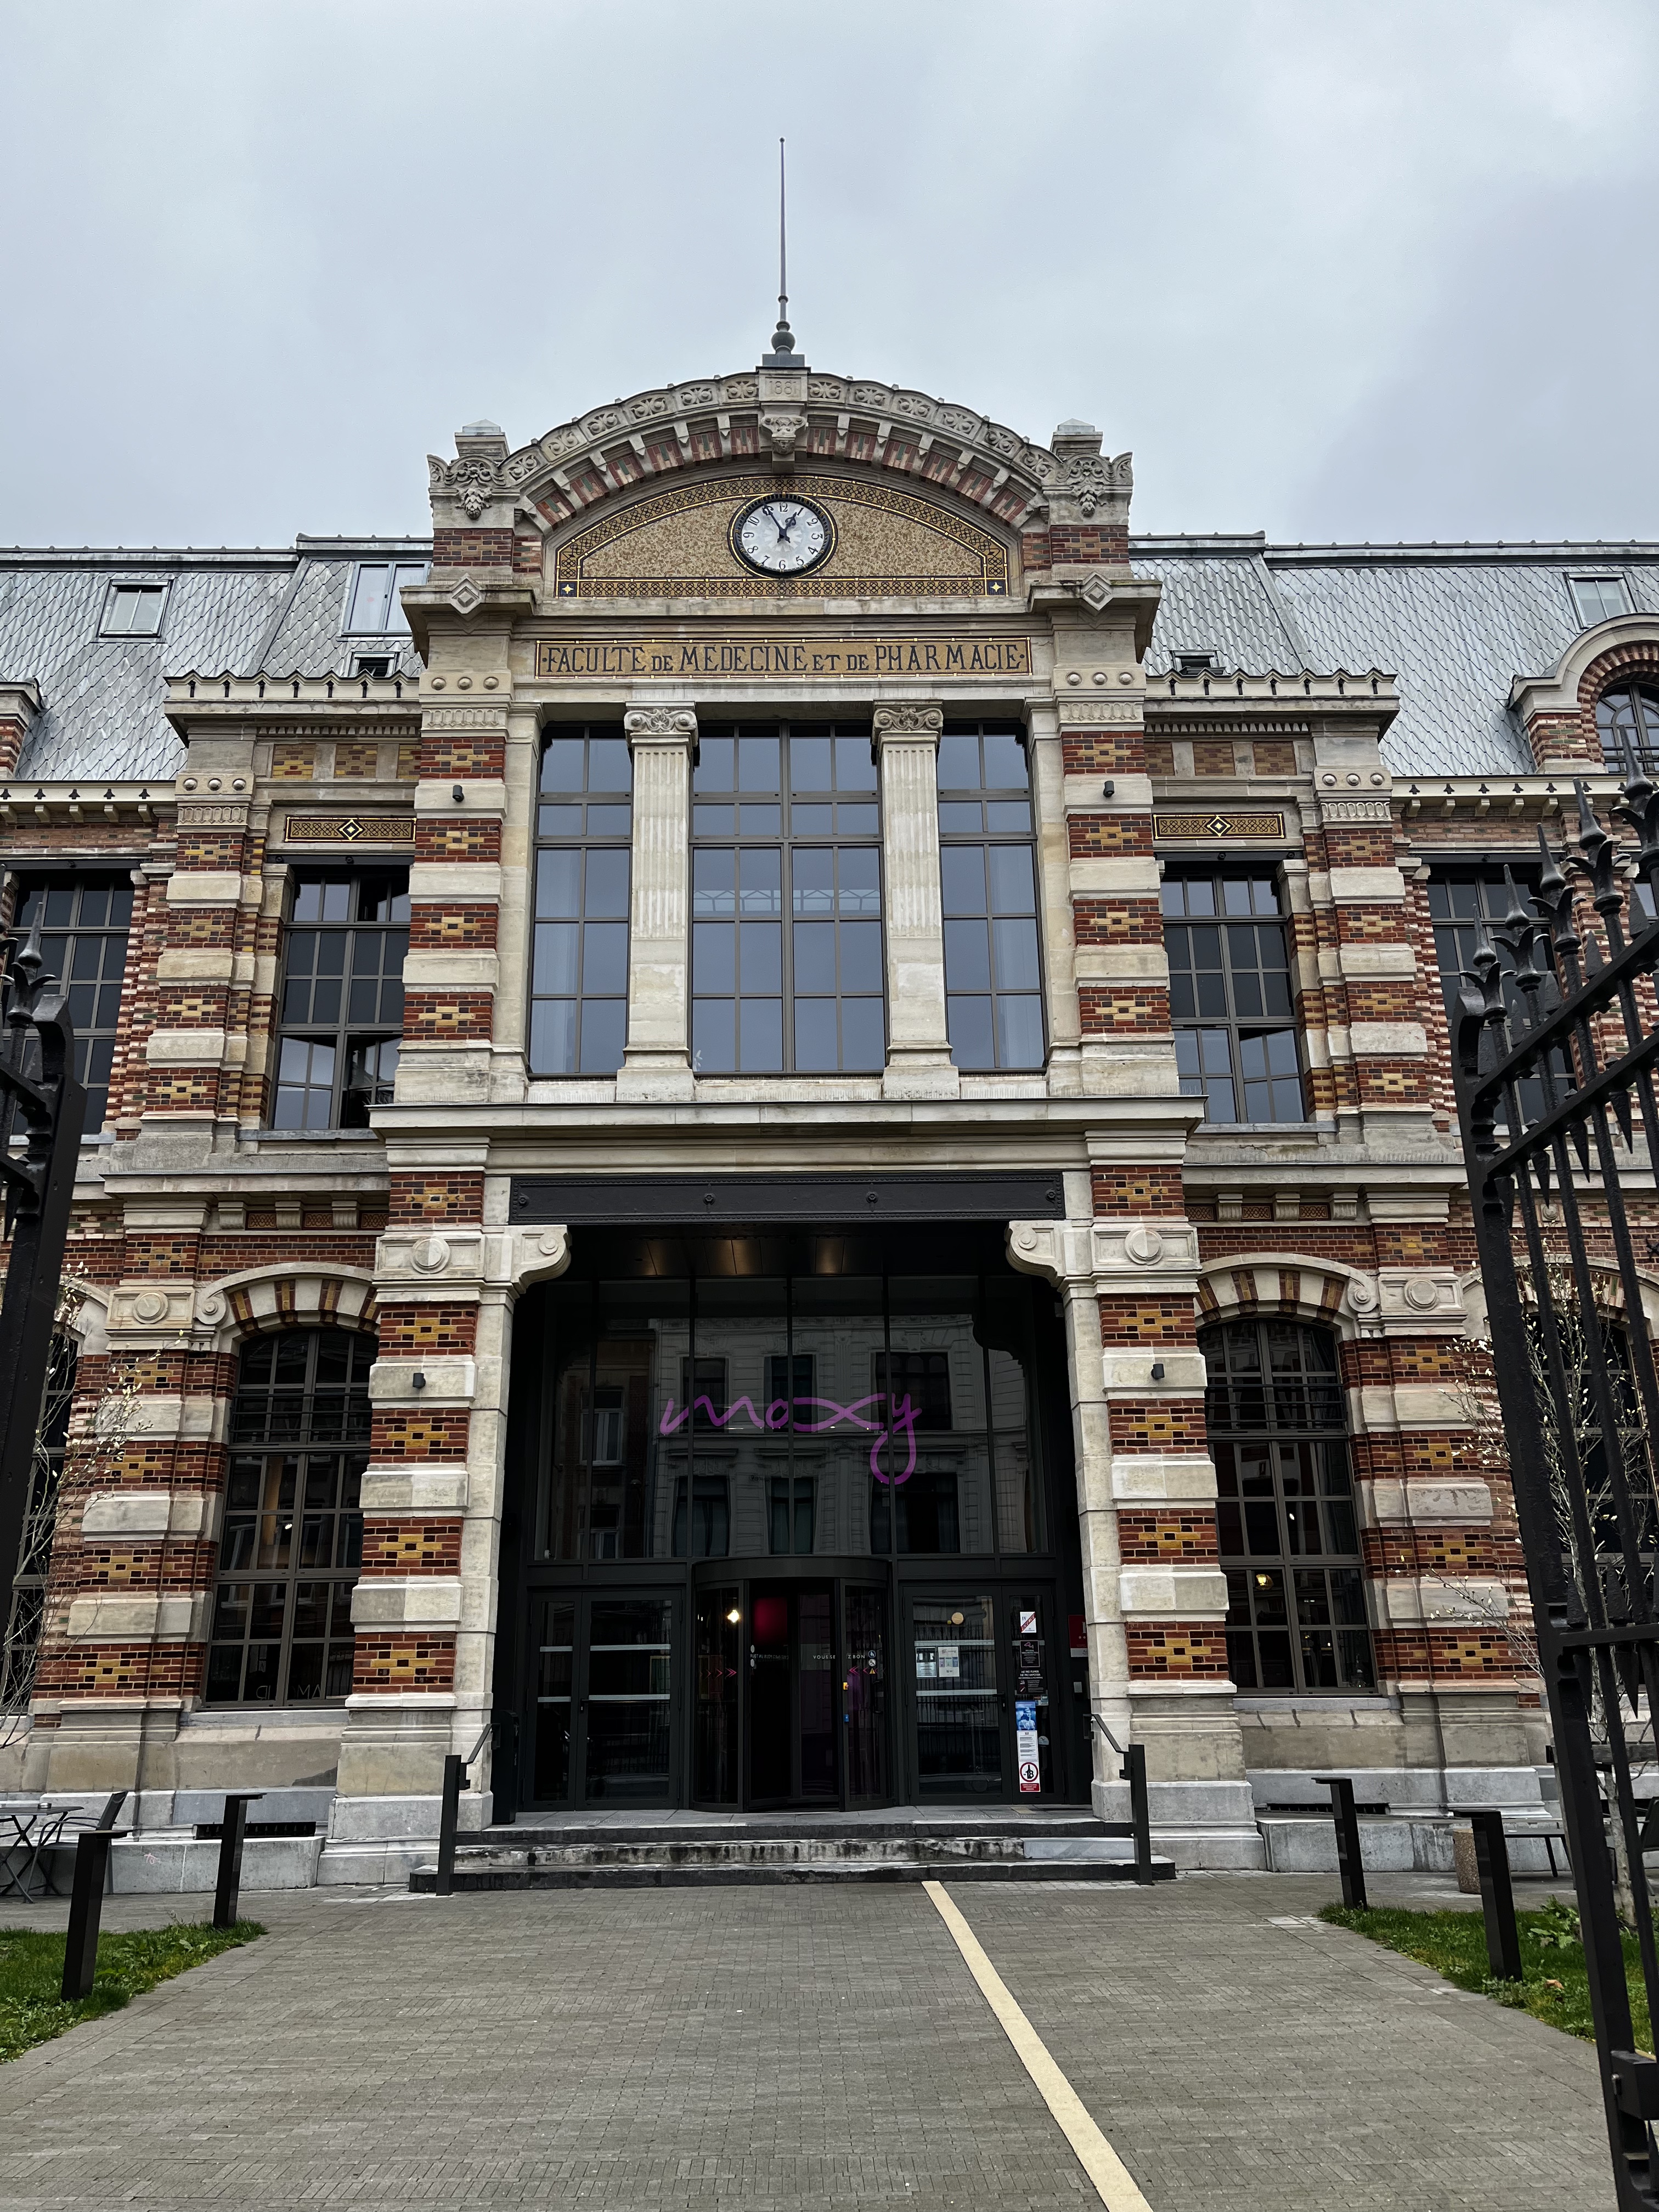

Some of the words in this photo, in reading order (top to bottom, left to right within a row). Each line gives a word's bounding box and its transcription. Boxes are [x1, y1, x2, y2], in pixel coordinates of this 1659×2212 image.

[769, 381, 797, 395] 1881
[779, 502, 788, 512] 12
[797, 507, 804, 516] 1
[747, 516, 760, 526] 10
[806, 518, 819, 526] 2
[808, 546, 819, 555] 4
[760, 555, 770, 566] 7
[779, 560, 786, 570] 6
[796, 555, 804, 566] 5
[651, 655, 673, 672] DE
[812, 654, 840, 671] ET
[847, 654, 869, 670] DE
[875, 645, 1021, 671] PHARMACIE
[660, 1392, 922, 1485] moxy
